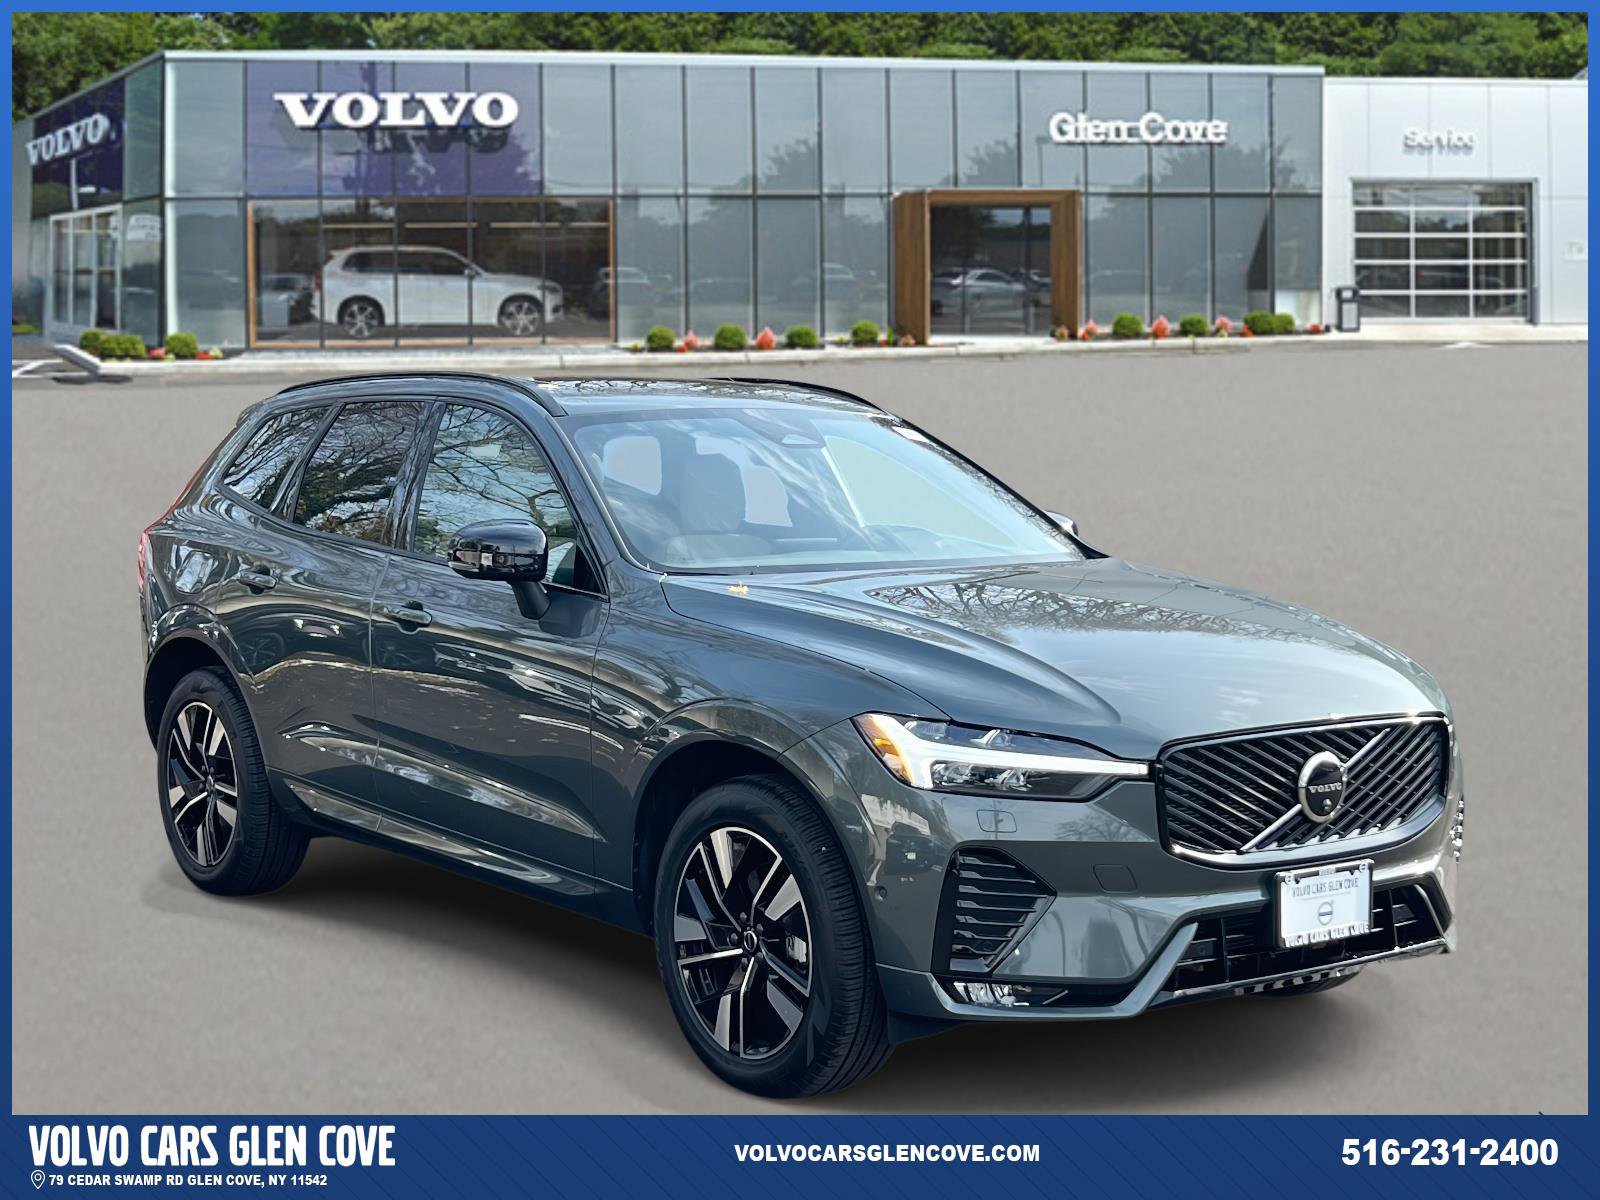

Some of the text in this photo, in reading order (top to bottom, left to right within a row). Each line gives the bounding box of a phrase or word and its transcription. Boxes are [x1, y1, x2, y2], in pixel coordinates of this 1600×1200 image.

[274, 91, 519, 128] VOLVO
[25, 113, 110, 165] VOLVO
[1049, 112, 1228, 143] Glen Cove
[1402, 127, 1476, 153] Service
[1308, 782, 1342, 793] VOLVO
[1293, 877, 1359, 897] VOLVO CARS GLEN COVE
